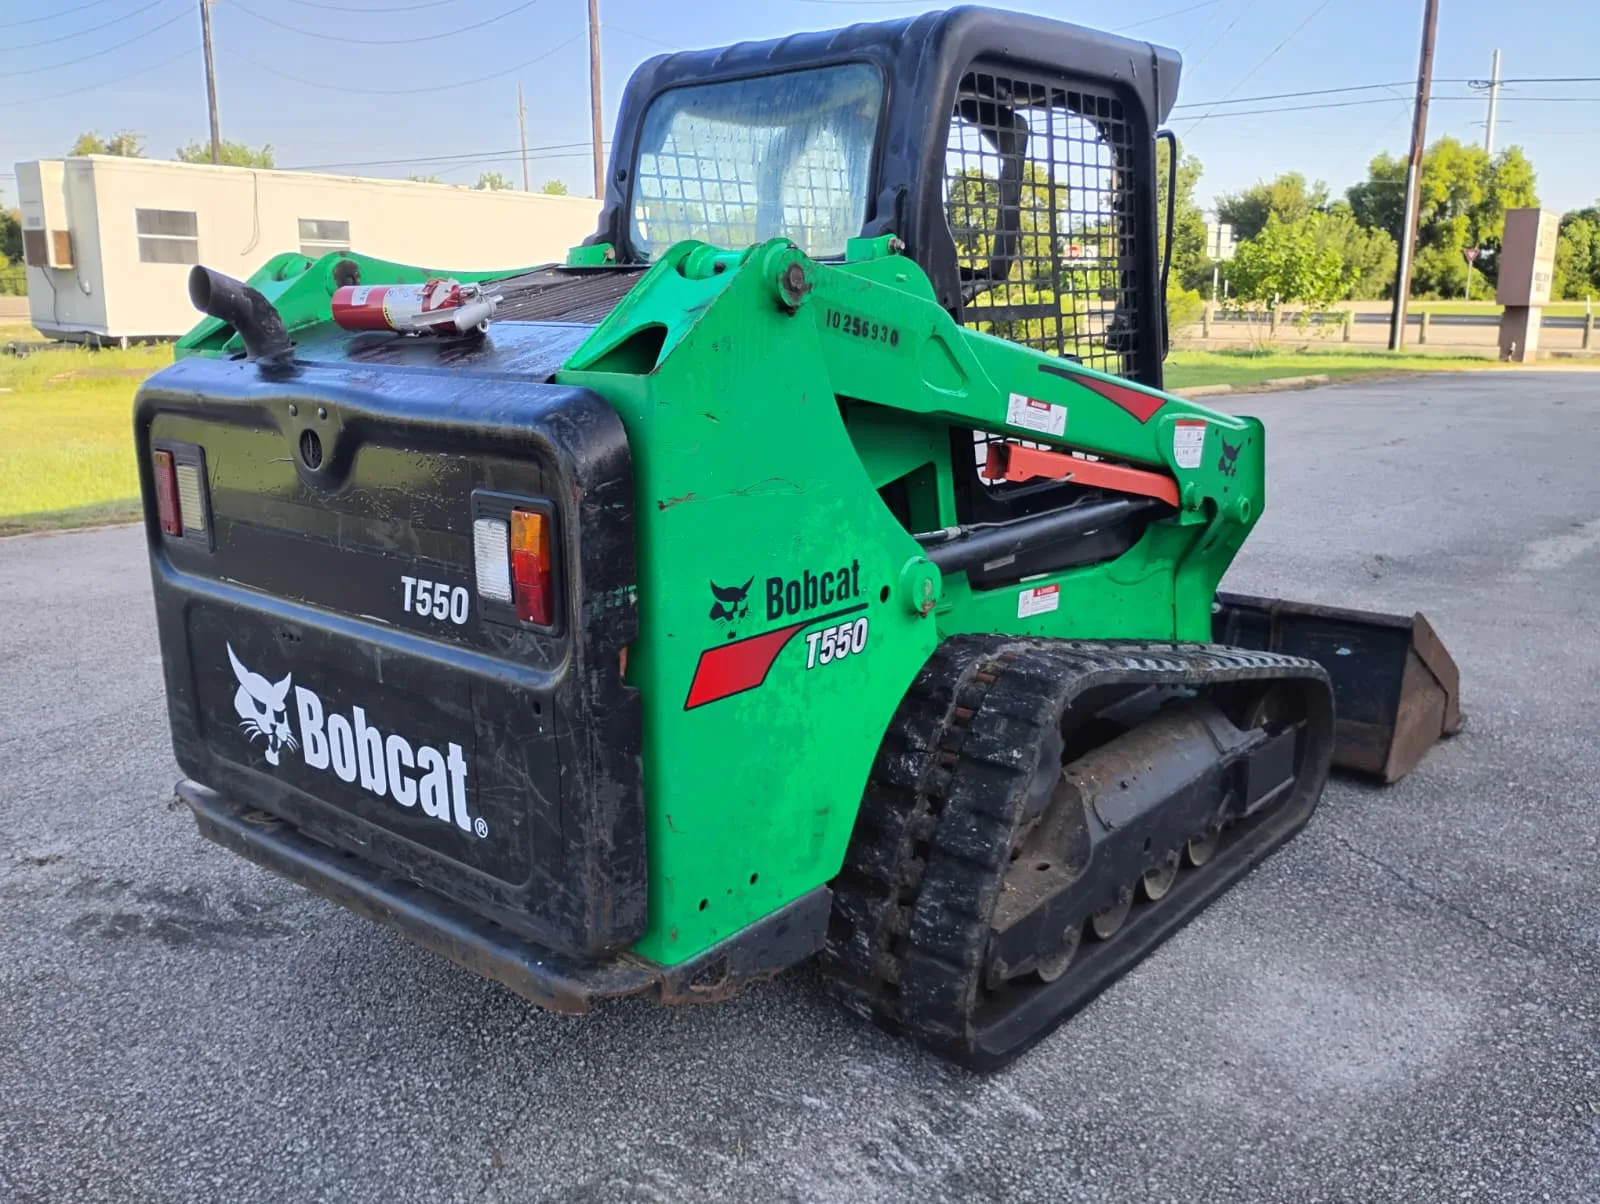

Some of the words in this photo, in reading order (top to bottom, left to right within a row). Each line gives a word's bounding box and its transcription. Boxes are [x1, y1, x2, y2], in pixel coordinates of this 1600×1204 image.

[825, 308, 899, 347] 10256930
[401, 576, 469, 625] T550
[766, 559, 859, 621] Bobcat
[805, 617, 868, 669] T550
[295, 686, 472, 832] Bobcat
